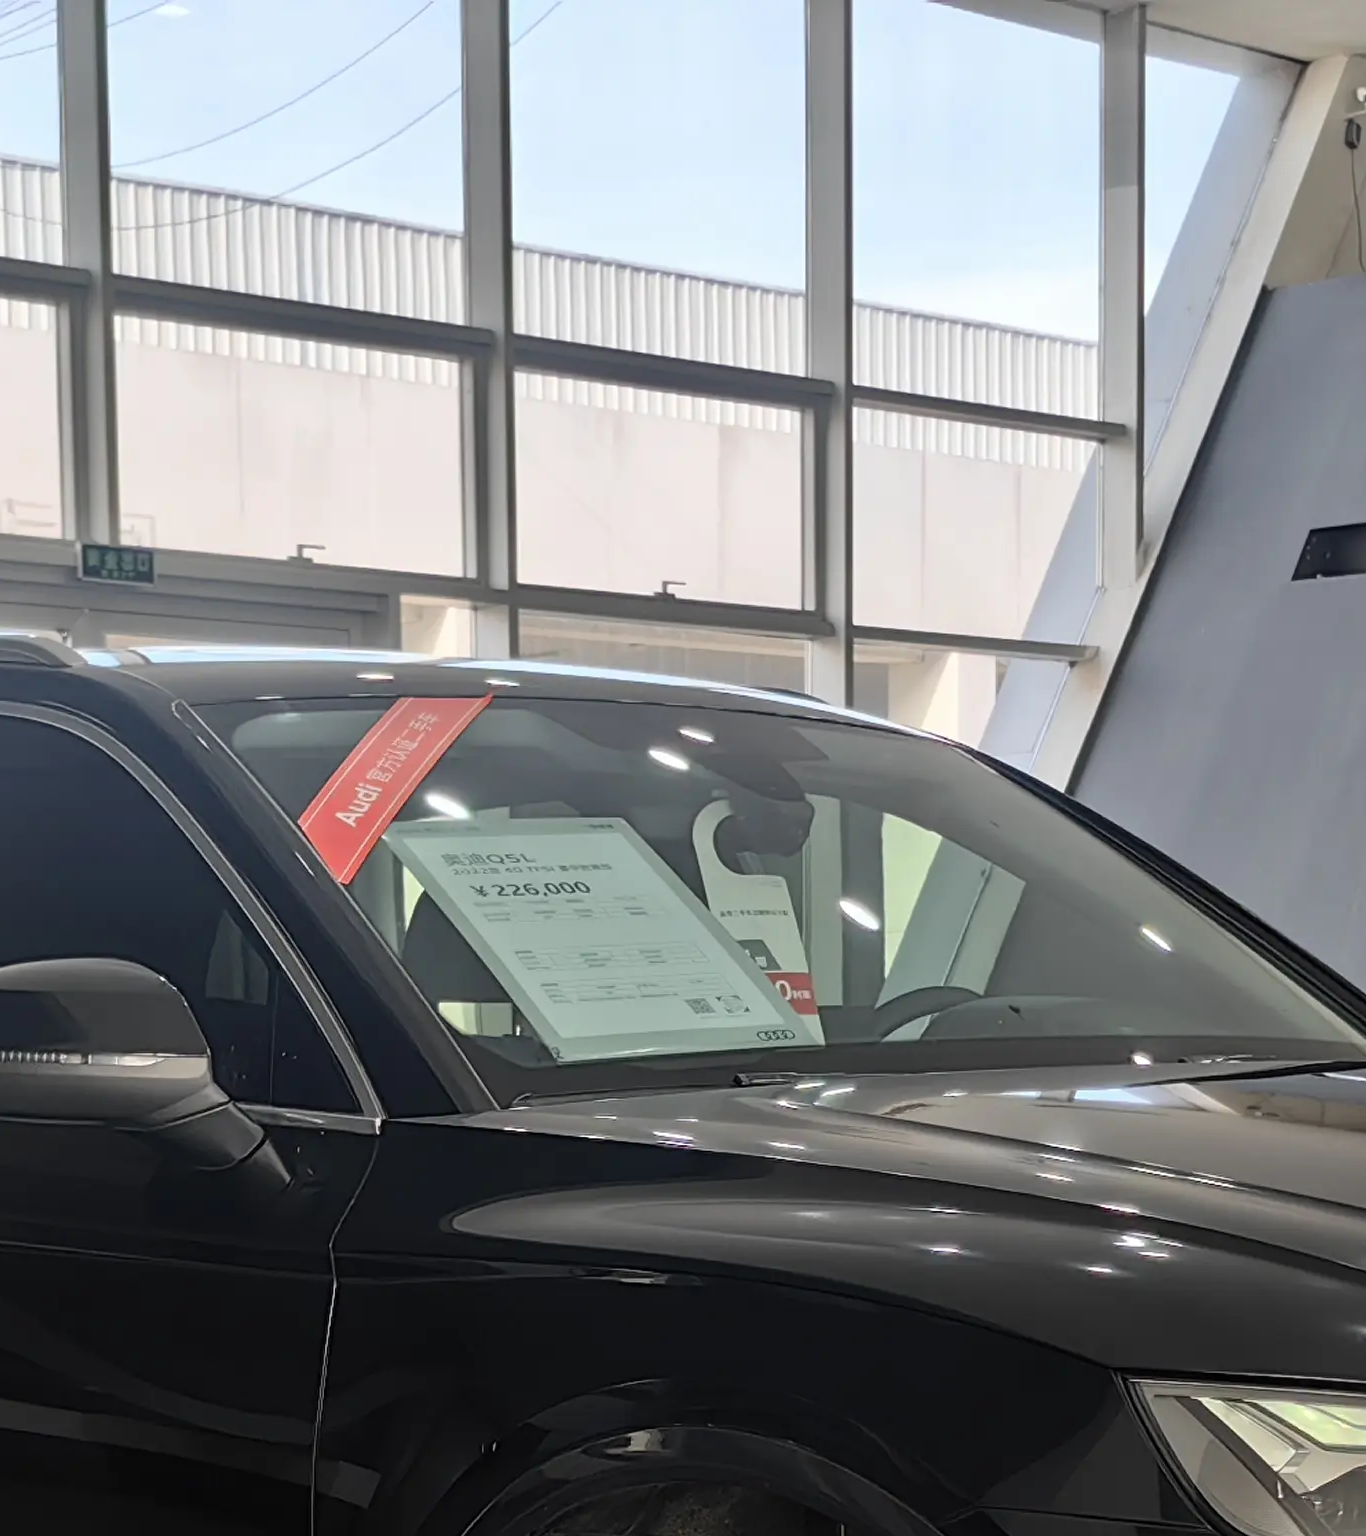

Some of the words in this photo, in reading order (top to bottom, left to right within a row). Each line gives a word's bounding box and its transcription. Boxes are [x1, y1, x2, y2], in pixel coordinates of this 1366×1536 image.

[335, 783, 383, 828] Audi
[366, 711, 441, 784] 官方认证二手车
[441, 852, 537, 867] 奥迪Q5L
[469, 880, 592, 898] ¥226,000
